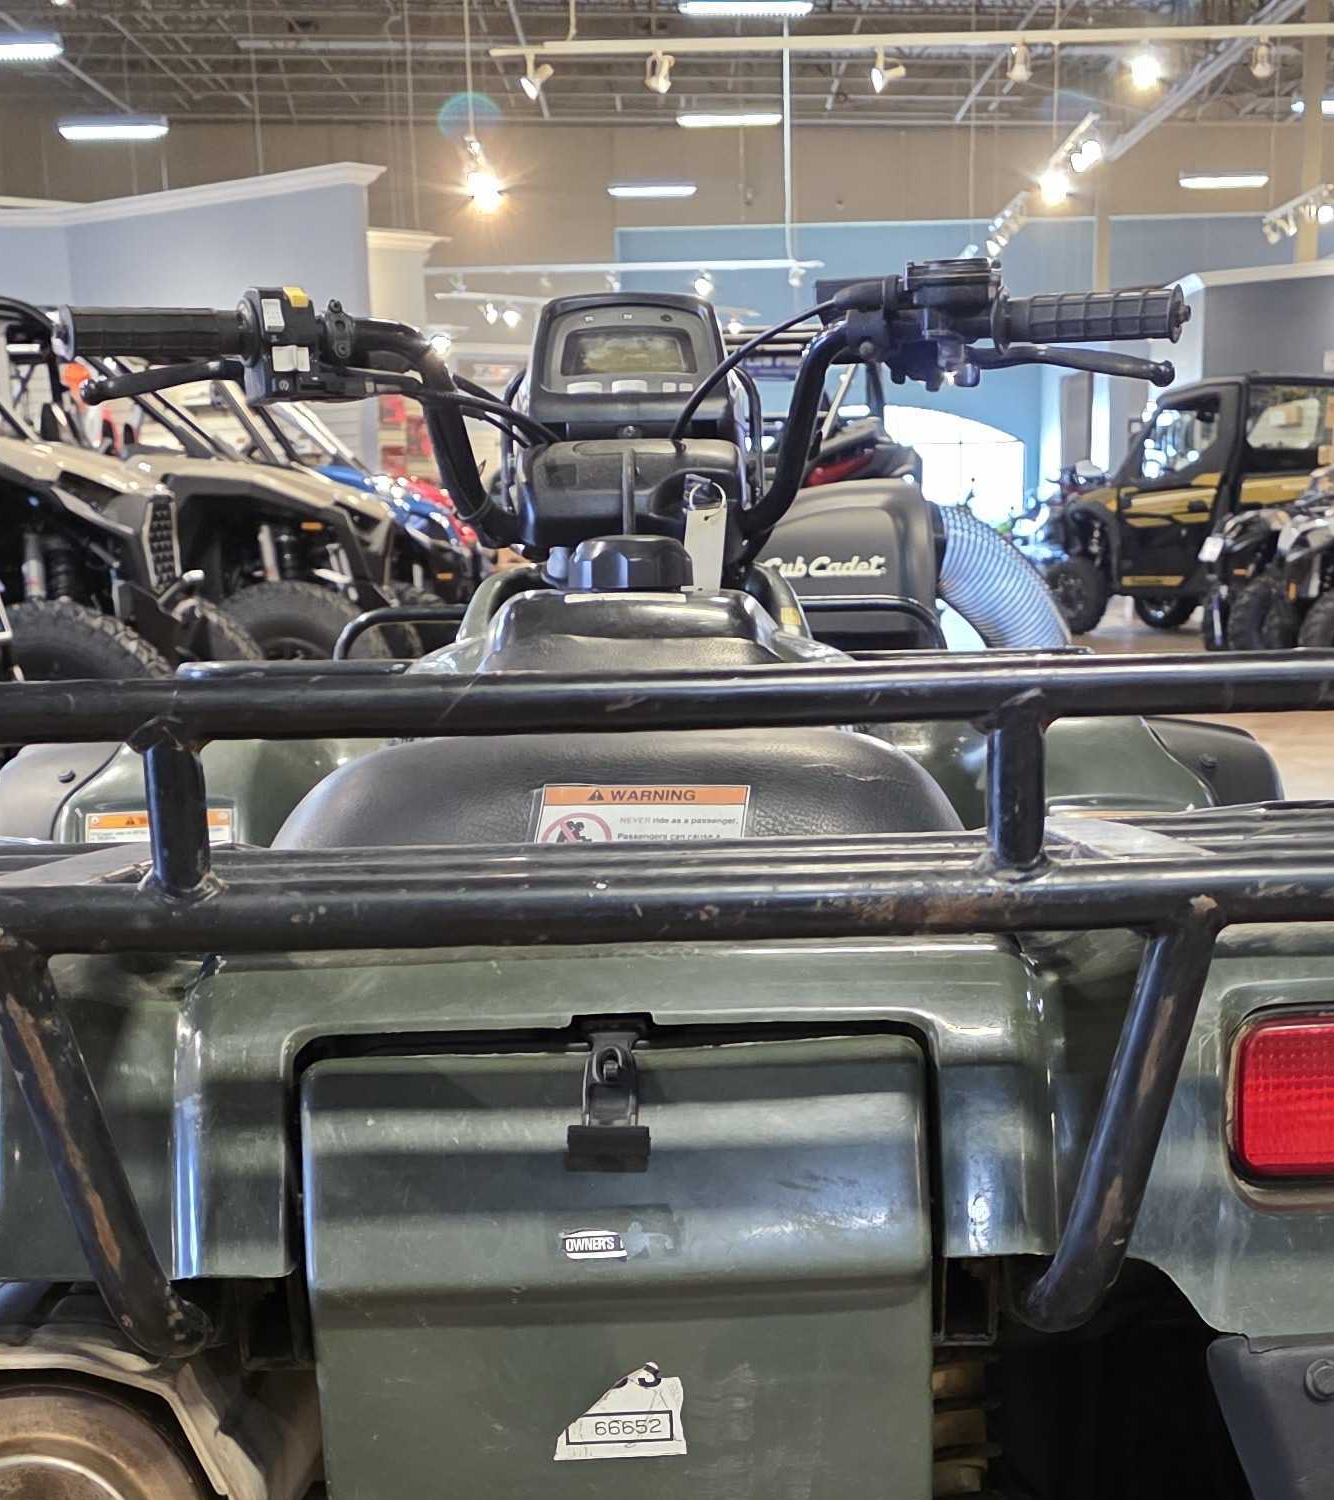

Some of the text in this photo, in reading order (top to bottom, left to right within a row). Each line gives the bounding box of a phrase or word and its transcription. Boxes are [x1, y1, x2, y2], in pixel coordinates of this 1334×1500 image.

[808, 555, 886, 578] Cadet
[610, 789, 697, 801] WARNING
[652, 816, 669, 824] ride
[594, 1418, 663, 1436] 66652
